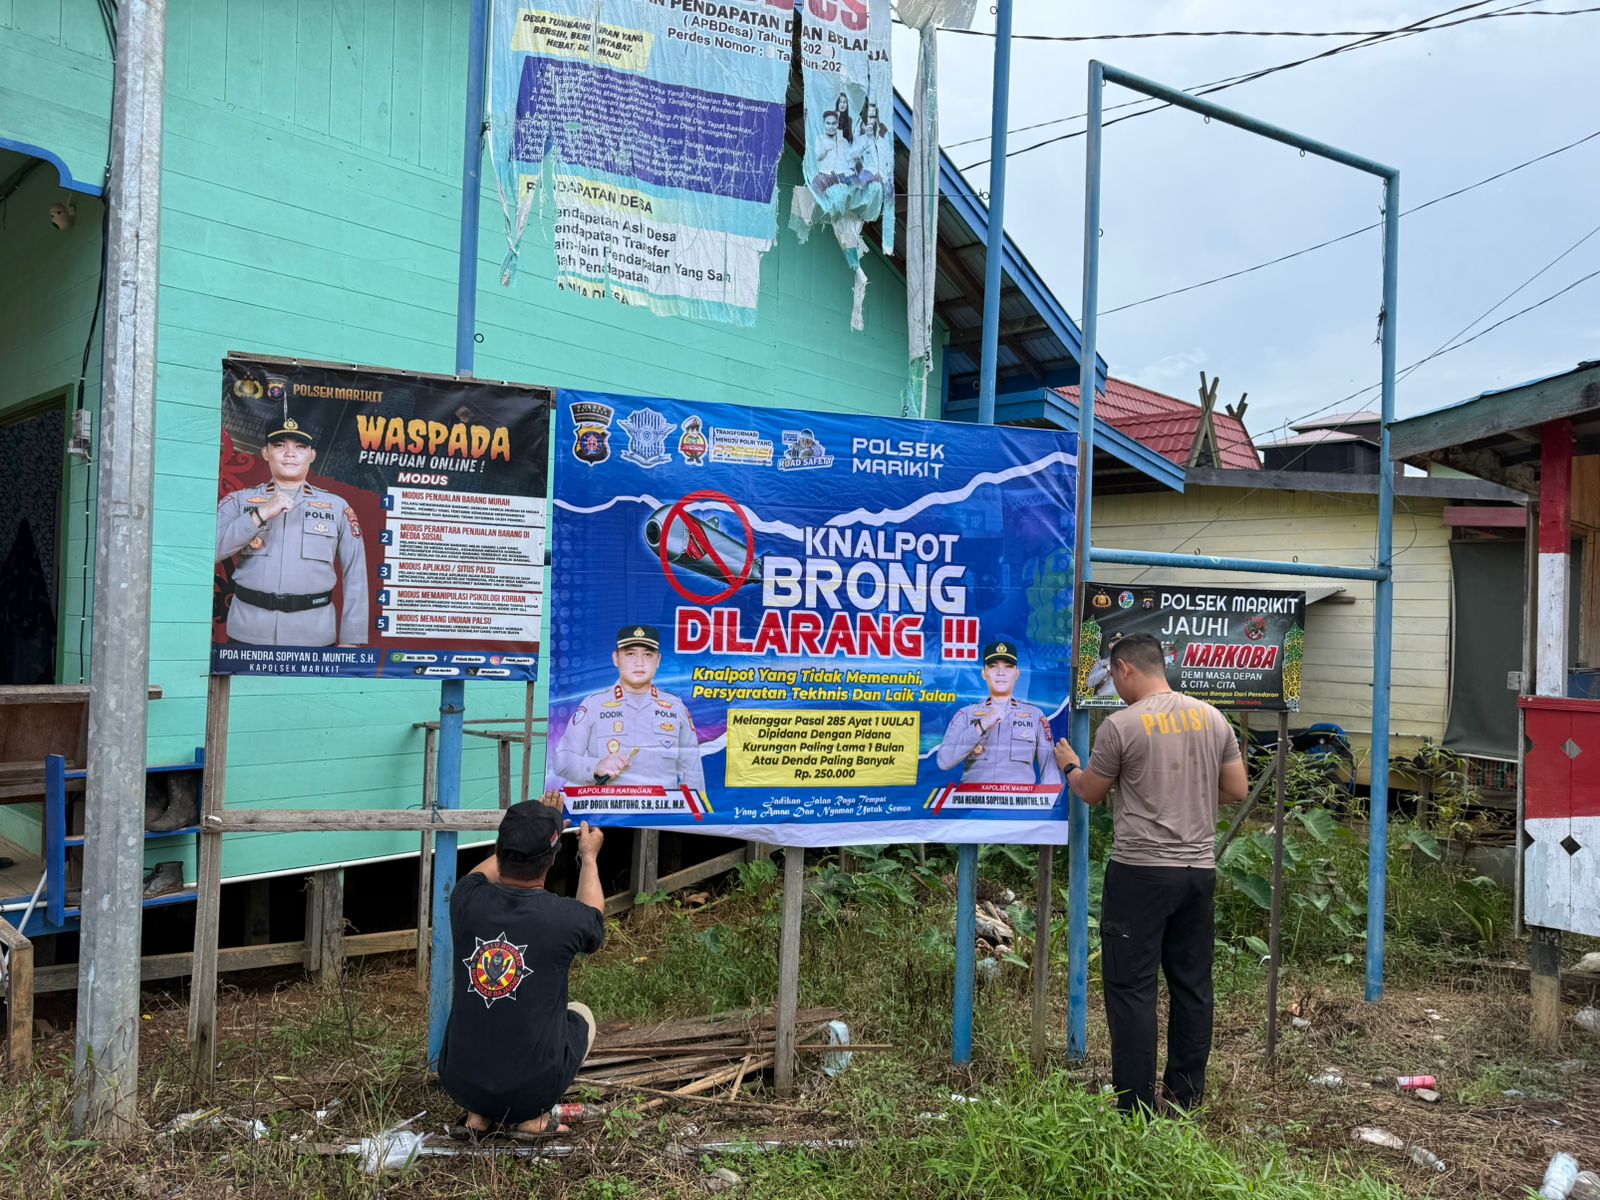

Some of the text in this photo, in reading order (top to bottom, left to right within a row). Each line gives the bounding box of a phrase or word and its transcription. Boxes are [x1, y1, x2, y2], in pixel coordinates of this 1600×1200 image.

[671, 0, 781, 31] PENDAPATAN
[523, 14, 546, 24] DESA
[622, 33, 644, 43] YANG
[533, 26, 568, 40] BERSIH,
[691, 16, 792, 47] APBDesa) Tahun
[668, 28, 711, 46] Perdes
[715, 37, 757, 54] Nomor
[621, 194, 653, 214] DESA
[647, 227, 677, 242] Desa
[675, 262, 703, 281] Yang
[293, 384, 384, 403] POLSEK MARIKIT
[356, 414, 511, 462] WASPADA
[715, 428, 758, 437] TRANSFORMASI
[756, 439, 772, 447] YANG
[852, 437, 945, 460] POLSEK
[358, 450, 427, 469] PENIPUAN
[429, 456, 478, 473] ONLINE
[779, 458, 802, 468] ROAD
[803, 456, 833, 466] SAFETY
[852, 457, 944, 480] MARIKIT
[397, 472, 449, 485] MODUS
[384, 498, 390, 507] 1
[401, 491, 424, 500] MODUS
[462, 495, 487, 505] BARANG
[488, 498, 510, 506] MURAH
[305, 511, 335, 520] POLRI
[381, 523, 530, 542] 2 MODUS PERANTARA PENJUALAN BARANG DI
[400, 531, 443, 541] MEDIA SOSIAL
[805, 526, 960, 563] KNALPOT
[380, 567, 388, 577] 3
[399, 562, 421, 571] MODUS
[422, 563, 451, 573] APLIKASI
[457, 565, 475, 573] SITUS
[475, 566, 496, 574] PALSU
[762, 555, 966, 615] BRONG
[378, 591, 526, 603] 4 MODUS MEMANIPULASI PSIKOLOGI KORBAN
[1160, 593, 1298, 614] POLSEK MARIKIT
[378, 619, 385, 629] 5
[397, 614, 419, 622] MODUS
[420, 615, 447, 624] MENANG
[472, 617, 492, 625] PALSU
[1161, 616, 1229, 637] JAUHI
[675, 605, 925, 659] DILARANG
[220, 649, 239, 660] IPDA
[241, 650, 274, 661] HENDRA
[276, 651, 311, 662] SOPIYAN
[322, 653, 359, 664] MUNTHE,
[360, 654, 376, 664] S.H.
[1181, 642, 1279, 671] NARKOBA
[250, 663, 341, 673] KAPOLSEK MARIKIT
[692, 667, 923, 686] Knalpot Yang Tidak Memenuhi,
[1181, 671, 1263, 681] DEMI MASA DEPAN
[1189, 681, 1209, 689] CITA
[1216, 681, 1236, 690] CITA
[692, 685, 957, 703] Persyaratan Tekhnis Dan Laik Jalan
[600, 710, 624, 719] DODIK
[655, 710, 677, 719] POLRI
[733, 714, 792, 728] Melanggar
[794, 716, 825, 727] Pasal
[827, 716, 846, 727] 285
[848, 716, 872, 728] Ayat
[881, 716, 915, 728] UULAJ
[1140, 707, 1210, 737] POLISI
[1013, 720, 1033, 728] POLRI
[757, 729, 891, 743] Dipidana Dengan Pidana
[742, 743, 797, 755] Kurungan
[799, 743, 834, 755] Paling
[836, 743, 866, 753] Lama
[875, 743, 905, 753] Bulan
[752, 755, 896, 768] Atau Denda Paling Banyak
[794, 769, 856, 780] Rp. 250.000
[578, 787, 615, 795] KAPOLRES
[572, 800, 589, 811] AKBP
[590, 800, 609, 810] DODIK
[762, 795, 887, 808] Jadikan Jalan Raya Tempat
[734, 807, 757, 819] Yang
[759, 807, 790, 818] Aman
[793, 807, 815, 818] Dan
[816, 807, 854, 818] Nyaman
[856, 805, 883, 816] Untuk
